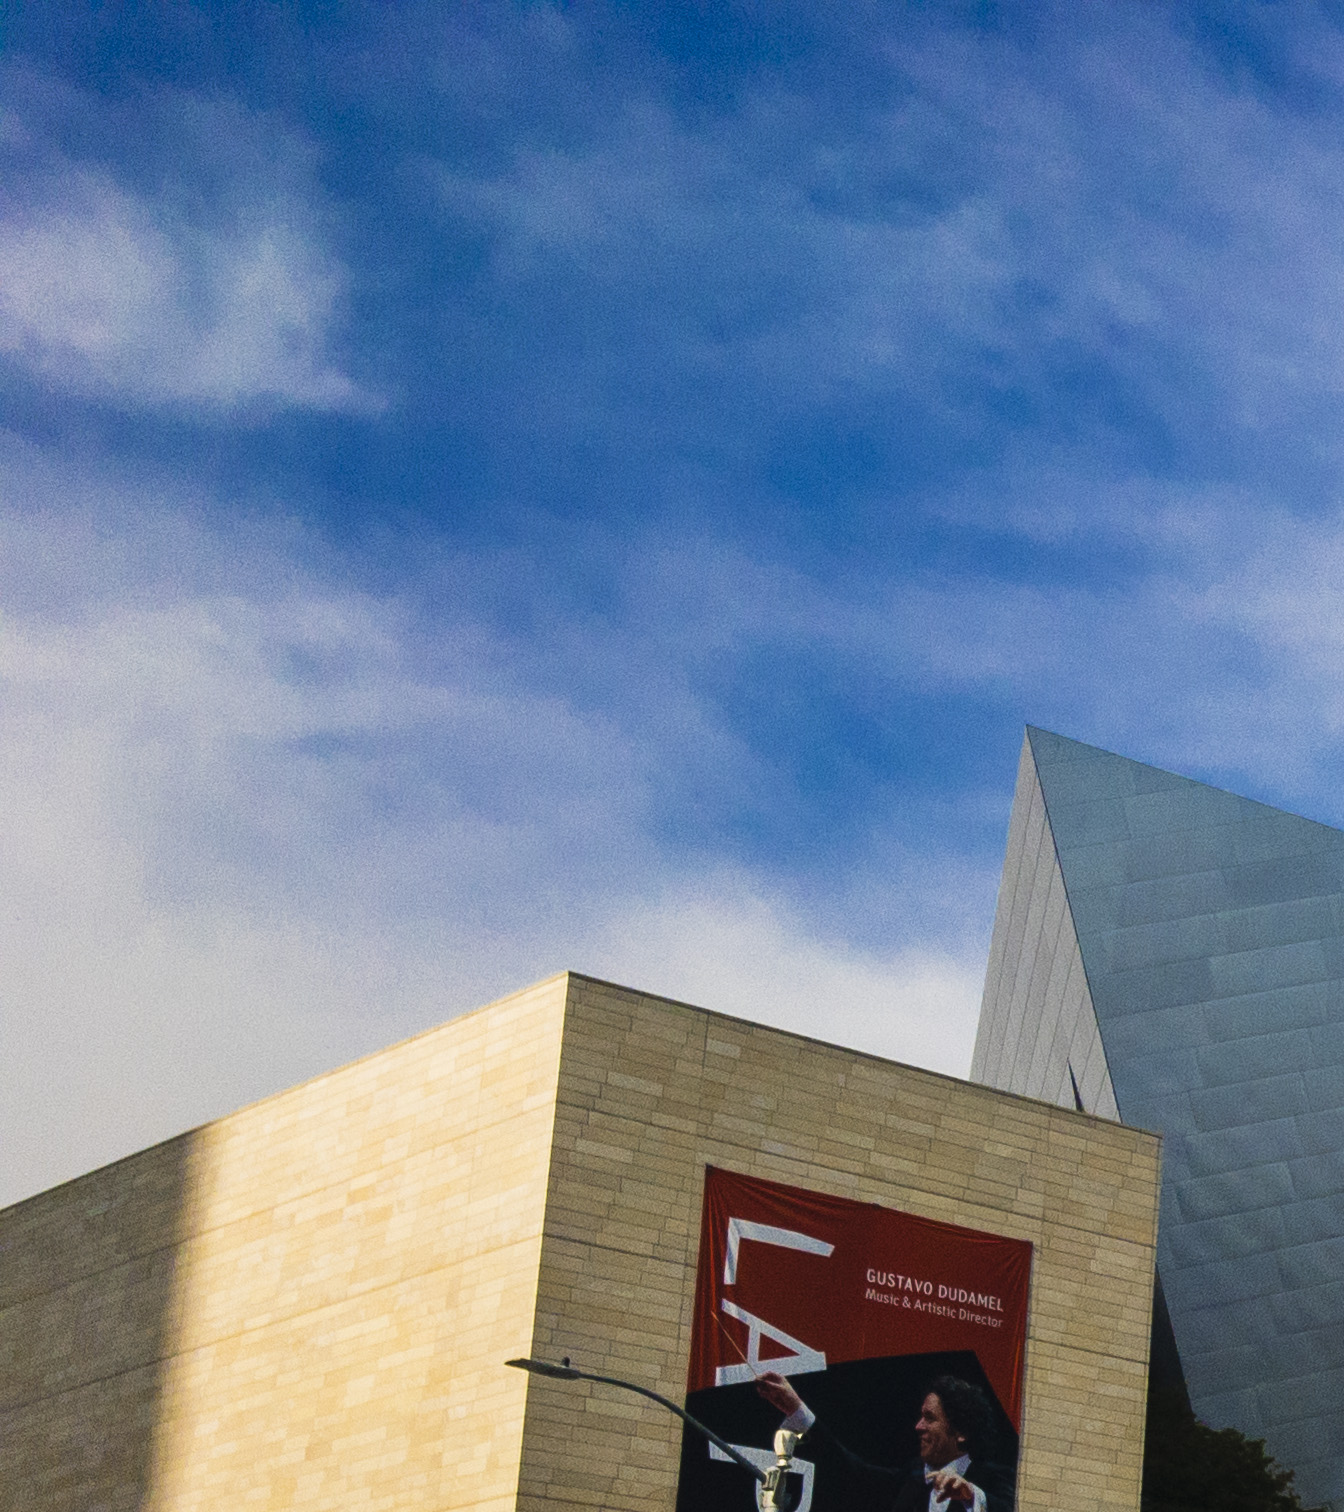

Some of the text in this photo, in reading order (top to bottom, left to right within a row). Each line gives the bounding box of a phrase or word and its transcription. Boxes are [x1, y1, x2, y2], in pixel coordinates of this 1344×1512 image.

[714, 1216, 836, 1387] LA
[865, 1288, 1004, 1328] Music & Artistic Director
[866, 1267, 1004, 1313] GUSTAVO DUDAMEL
